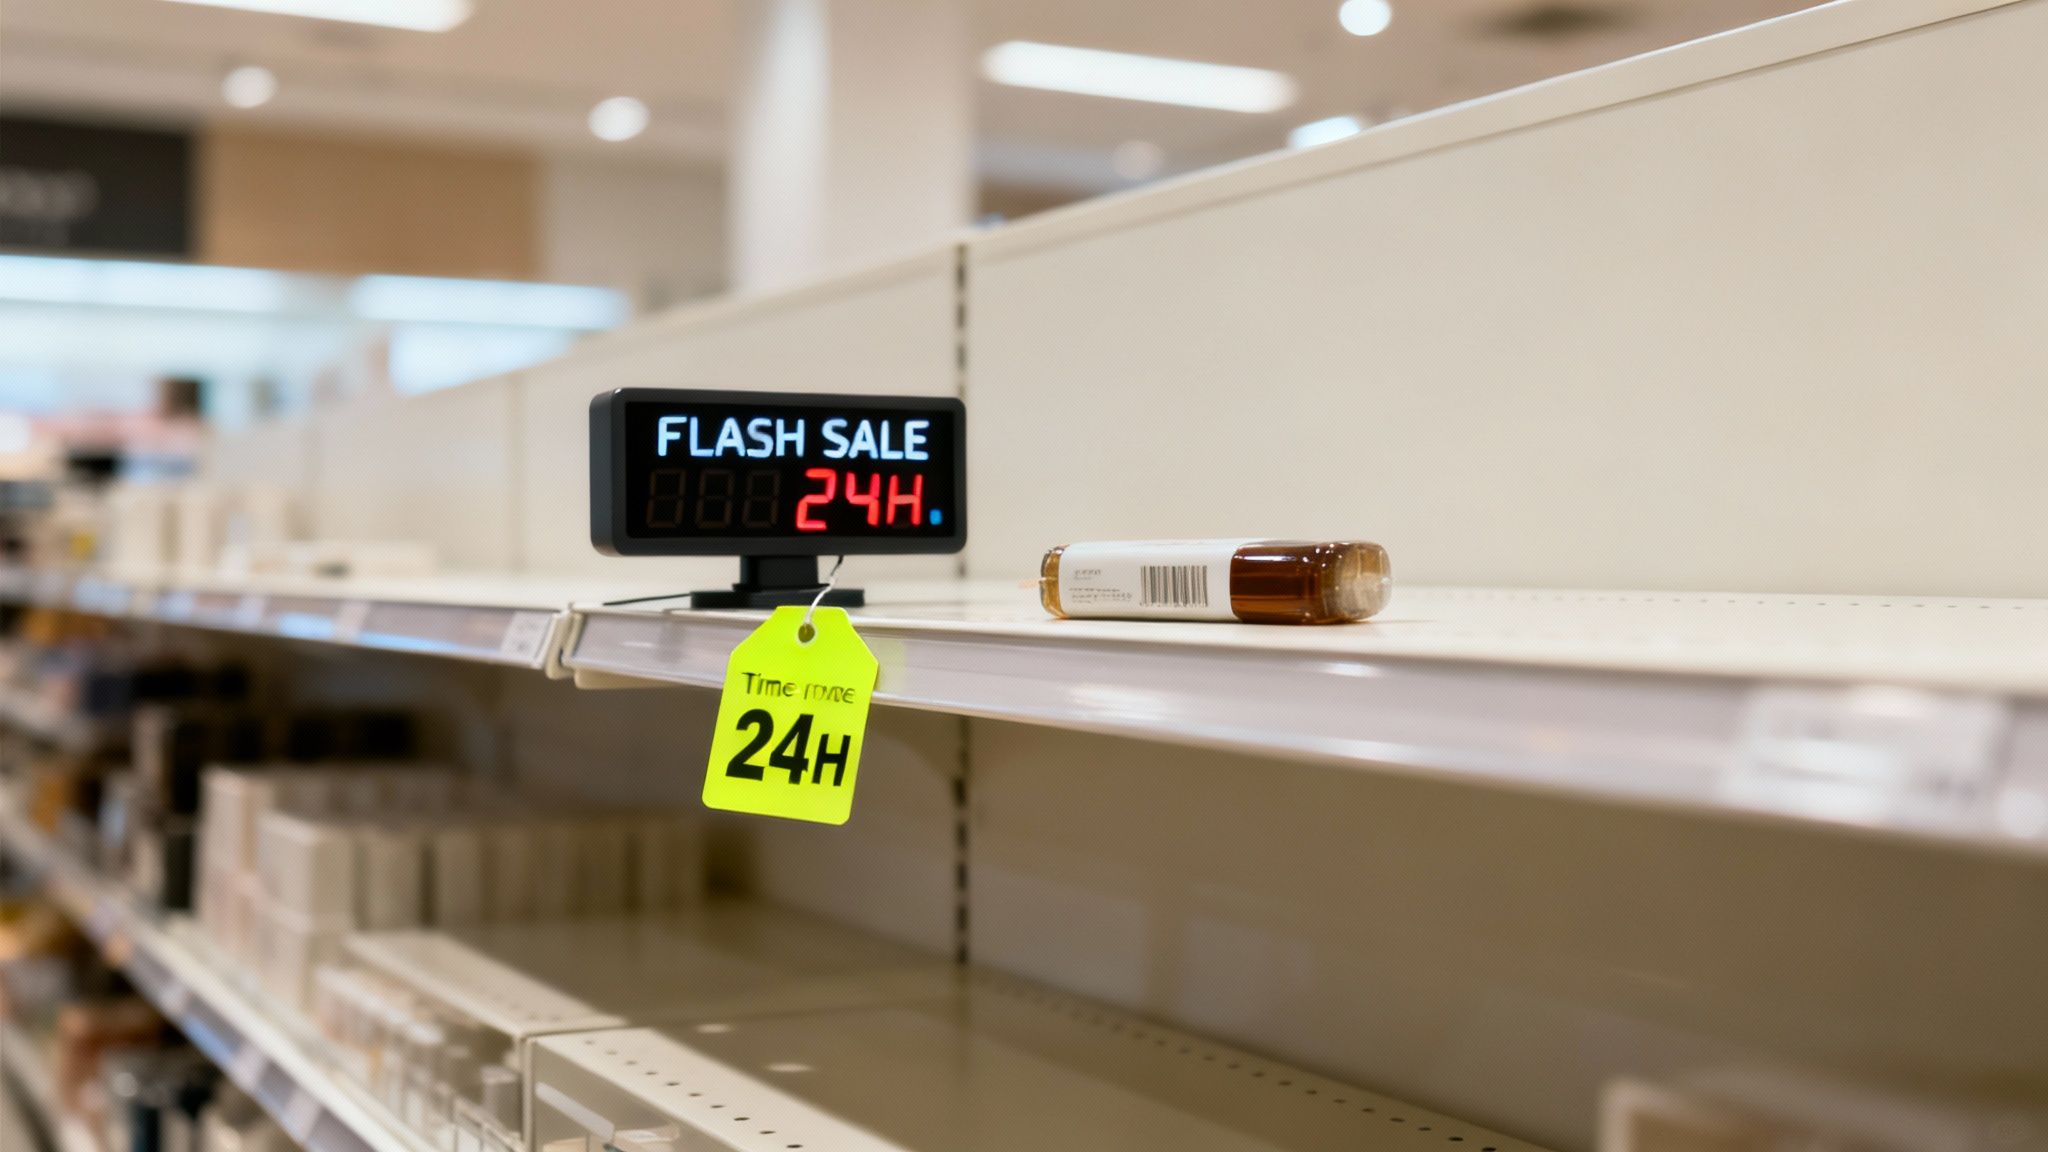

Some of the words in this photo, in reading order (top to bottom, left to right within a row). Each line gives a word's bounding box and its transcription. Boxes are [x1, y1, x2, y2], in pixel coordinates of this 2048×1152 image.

[657, 416, 806, 457] FLASH
[821, 419, 929, 461] SALE
[725, 708, 852, 787] 24H
